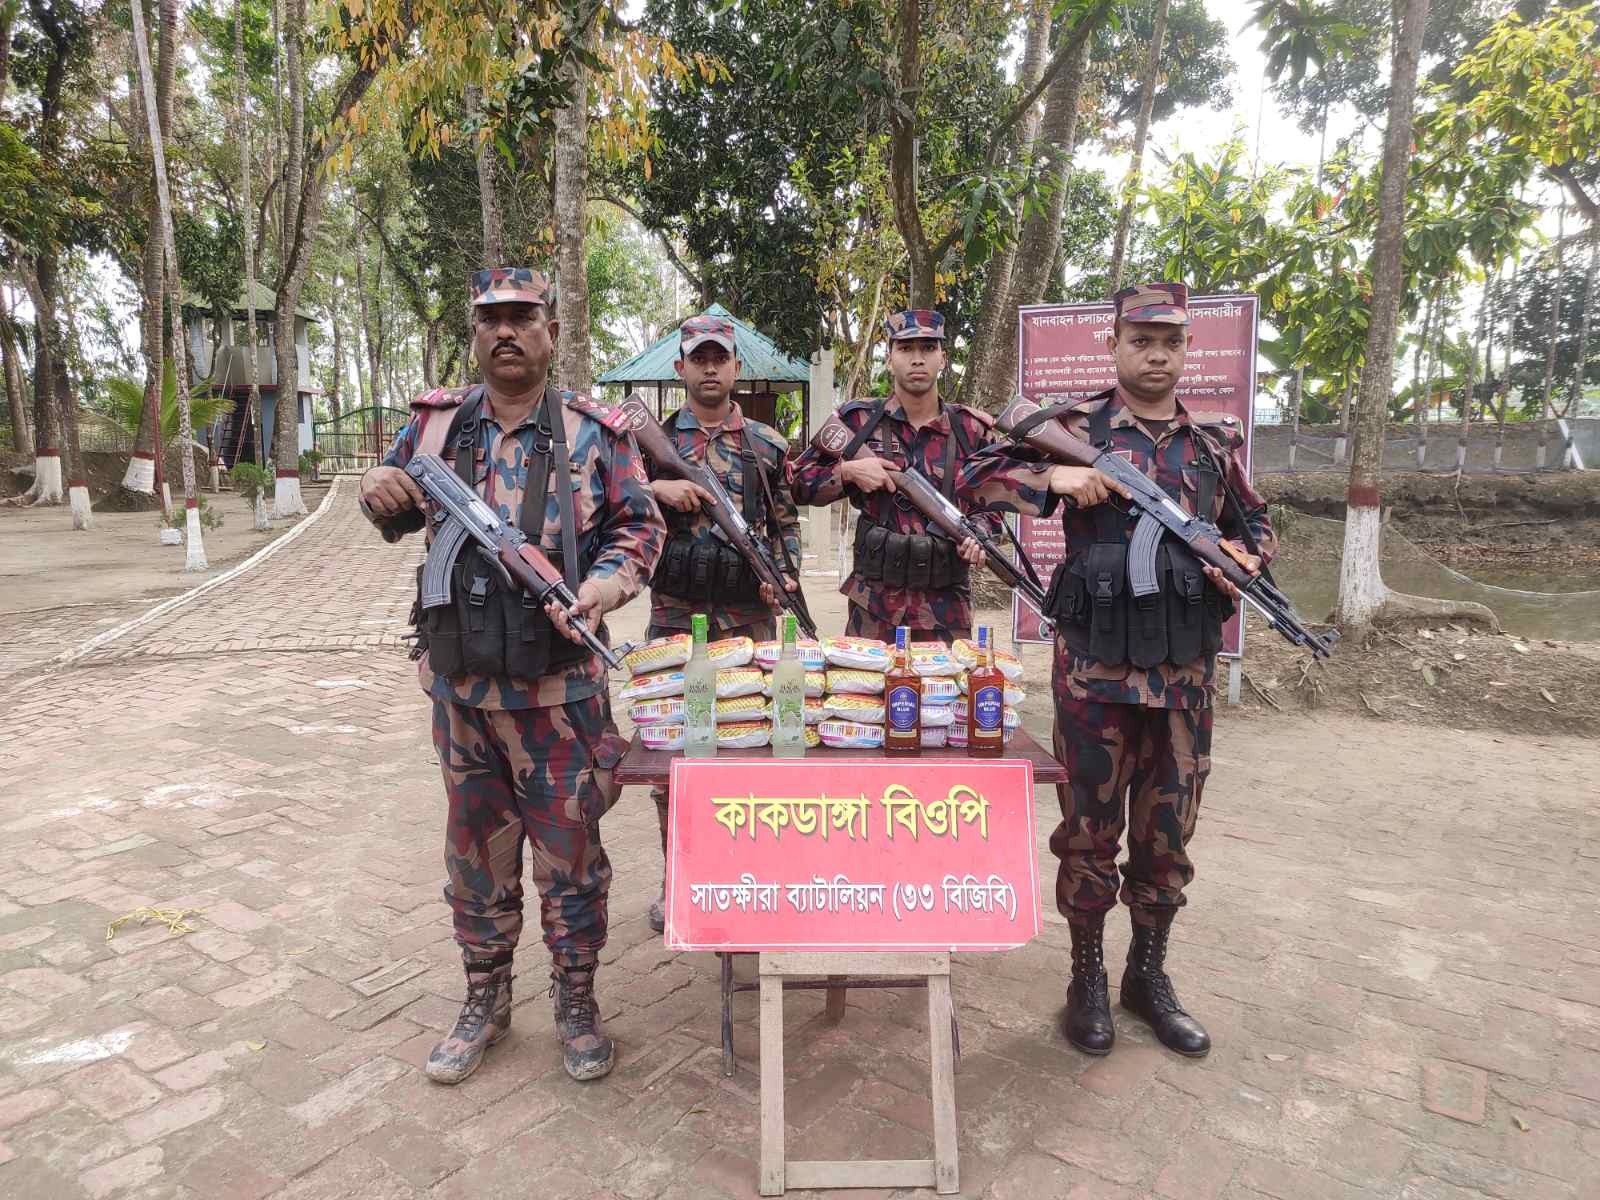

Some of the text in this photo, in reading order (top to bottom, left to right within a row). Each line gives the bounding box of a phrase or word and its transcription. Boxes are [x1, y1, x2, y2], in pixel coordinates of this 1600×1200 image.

[1032, 314, 1074, 328] যানবাহন
[710, 783, 991, 840] কাকডাঙ্গা বিওপি
[690, 872, 1018, 920] সাতক্ষীরা ব্যাটালিয়ন (৩৩ বিজিবি)
